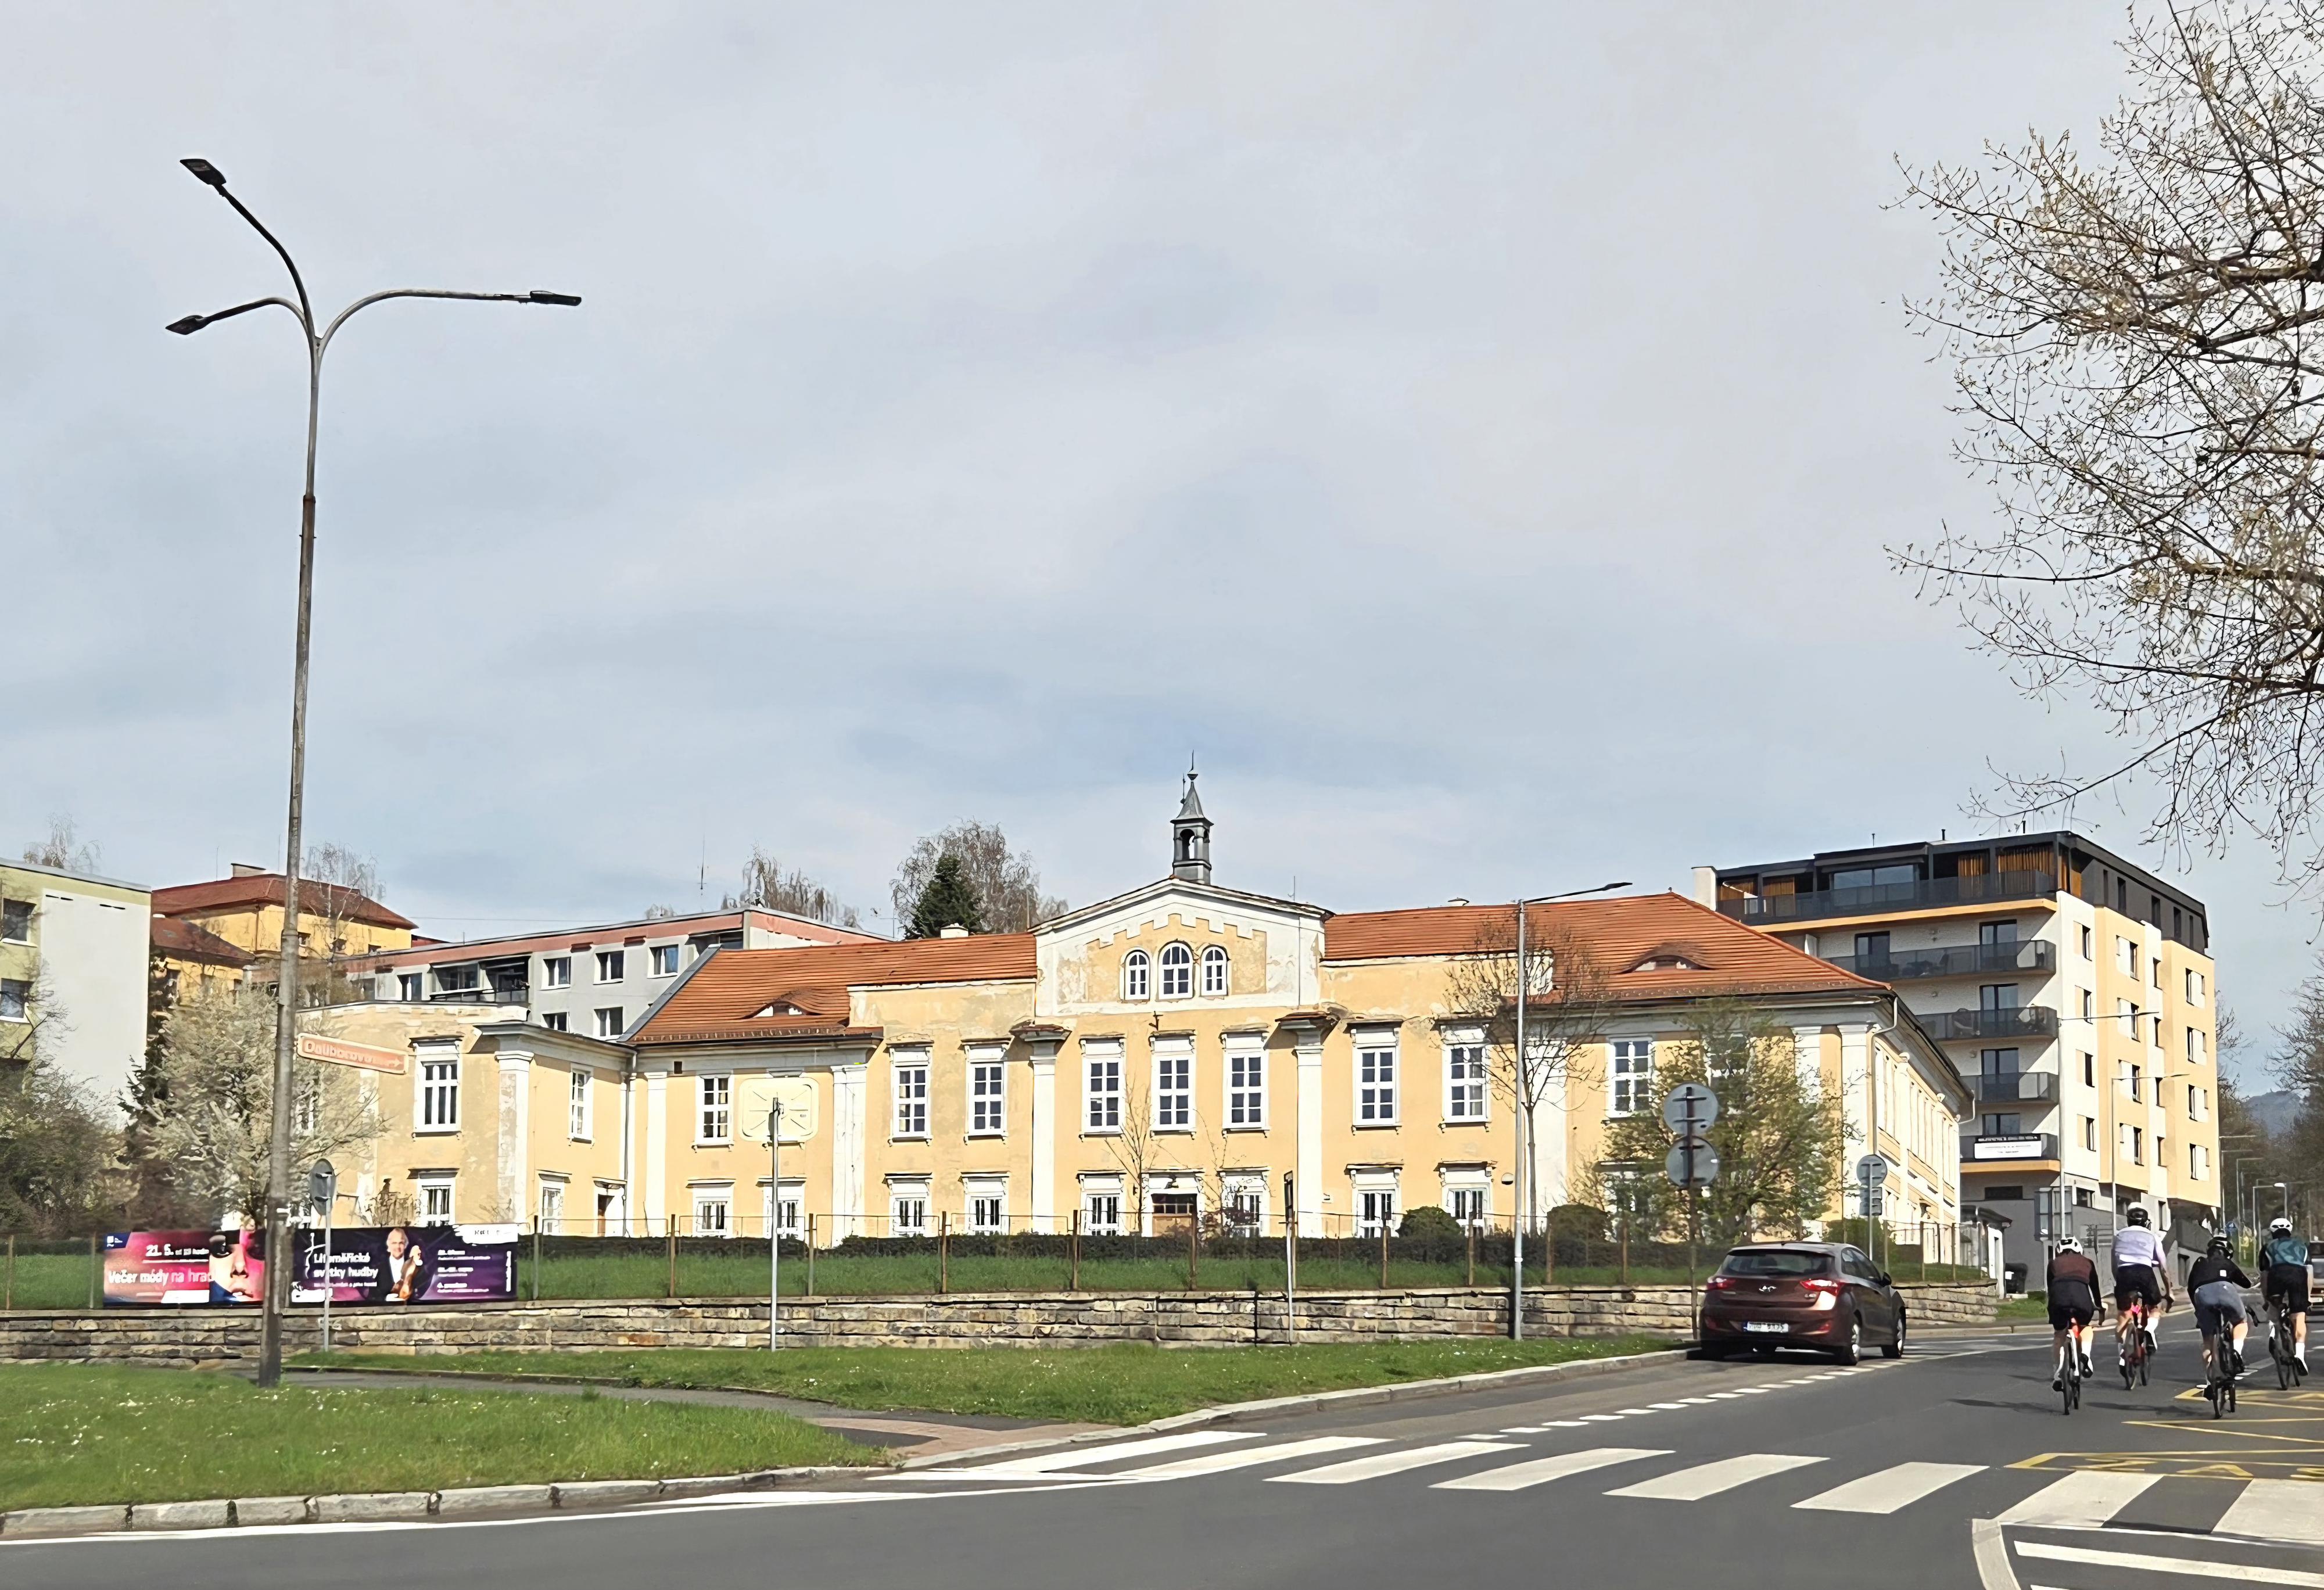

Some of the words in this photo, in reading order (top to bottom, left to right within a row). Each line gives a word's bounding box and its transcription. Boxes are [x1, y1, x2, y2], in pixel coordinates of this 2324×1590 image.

[313, 1252, 371, 1264] Litměřické
[109, 1269, 138, 1284] Večer
[139, 1268, 170, 1287] módy
[171, 1272, 185, 1283] na
